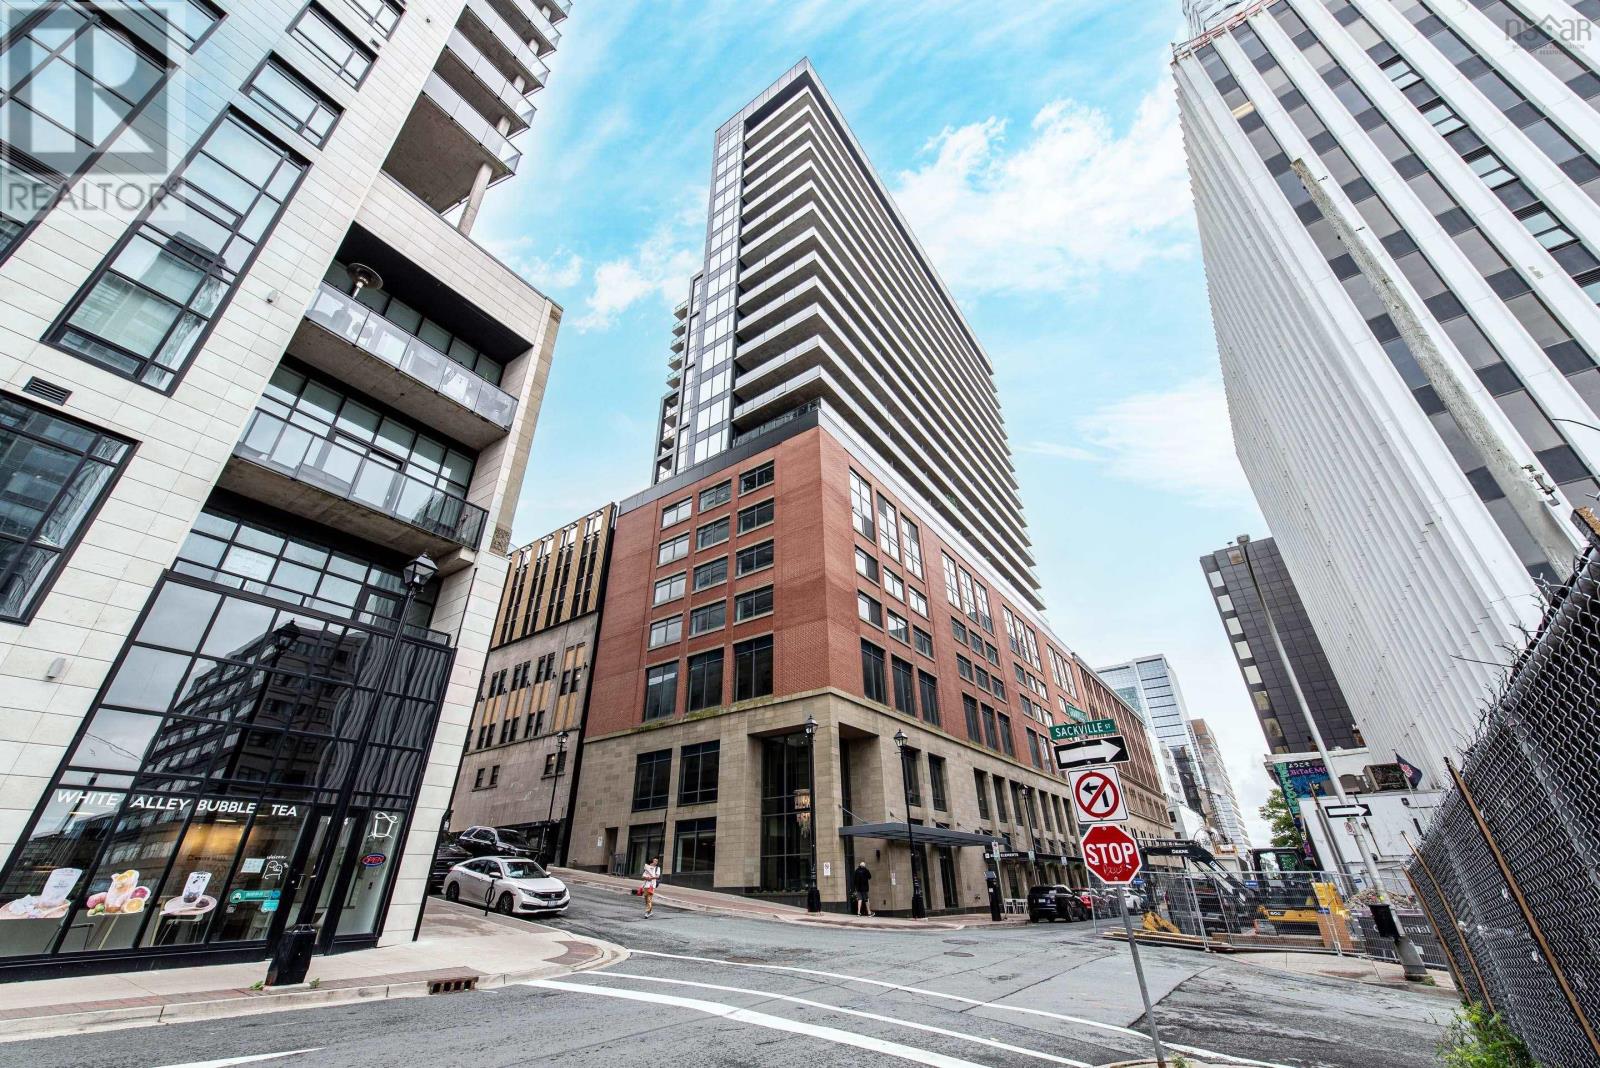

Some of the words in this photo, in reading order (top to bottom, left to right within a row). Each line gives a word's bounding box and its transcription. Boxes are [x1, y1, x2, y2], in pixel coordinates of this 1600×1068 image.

[1055, 722, 1104, 737] SACKVILLE
[57, 791, 119, 807] WHITE
[130, 796, 191, 812] ALLEY
[196, 799, 257, 814] BUBBLE
[271, 804, 298, 817] TEA
[1085, 842, 1135, 866] STOP
